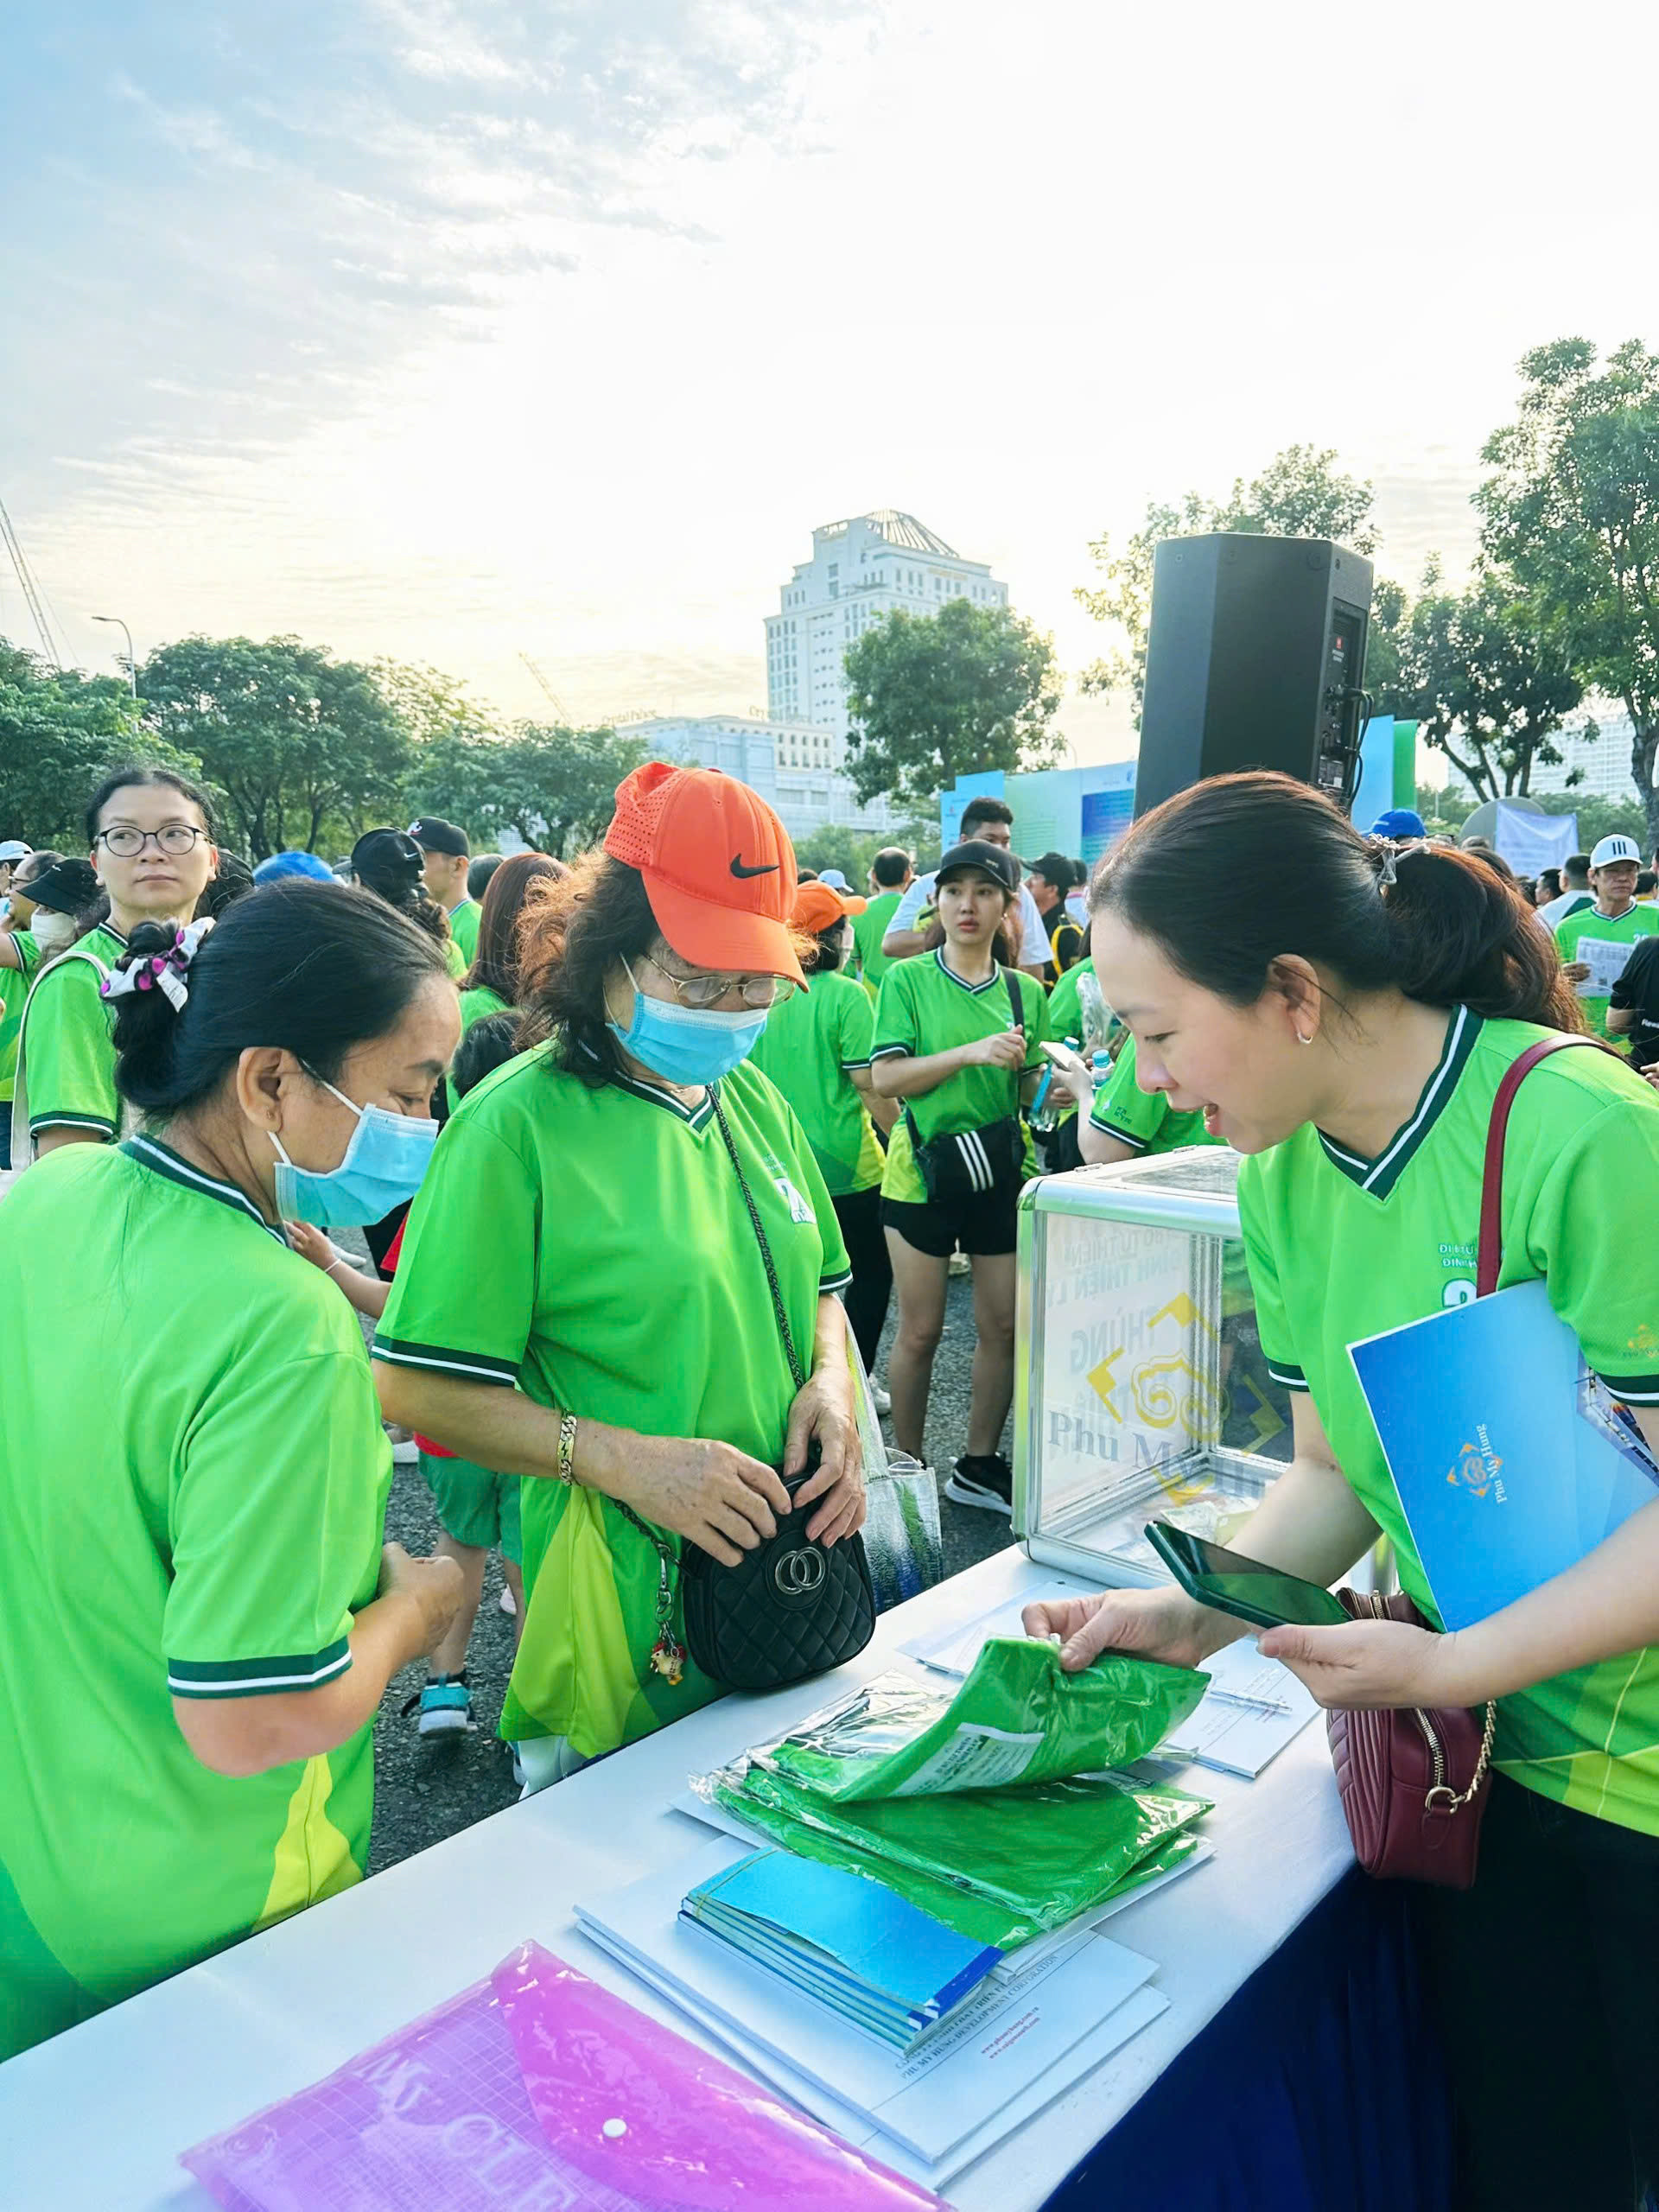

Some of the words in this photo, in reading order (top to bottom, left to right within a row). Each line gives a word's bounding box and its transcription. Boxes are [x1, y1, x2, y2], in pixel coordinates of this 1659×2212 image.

[1048, 1410, 1120, 1462] Phu
[1476, 1423, 1493, 1458] Hung
[1494, 1478, 1507, 1504] Phu
[957, 1994, 1009, 2039] DEVELOPMENT
[1008, 1955, 1059, 1996] CORPORATION
